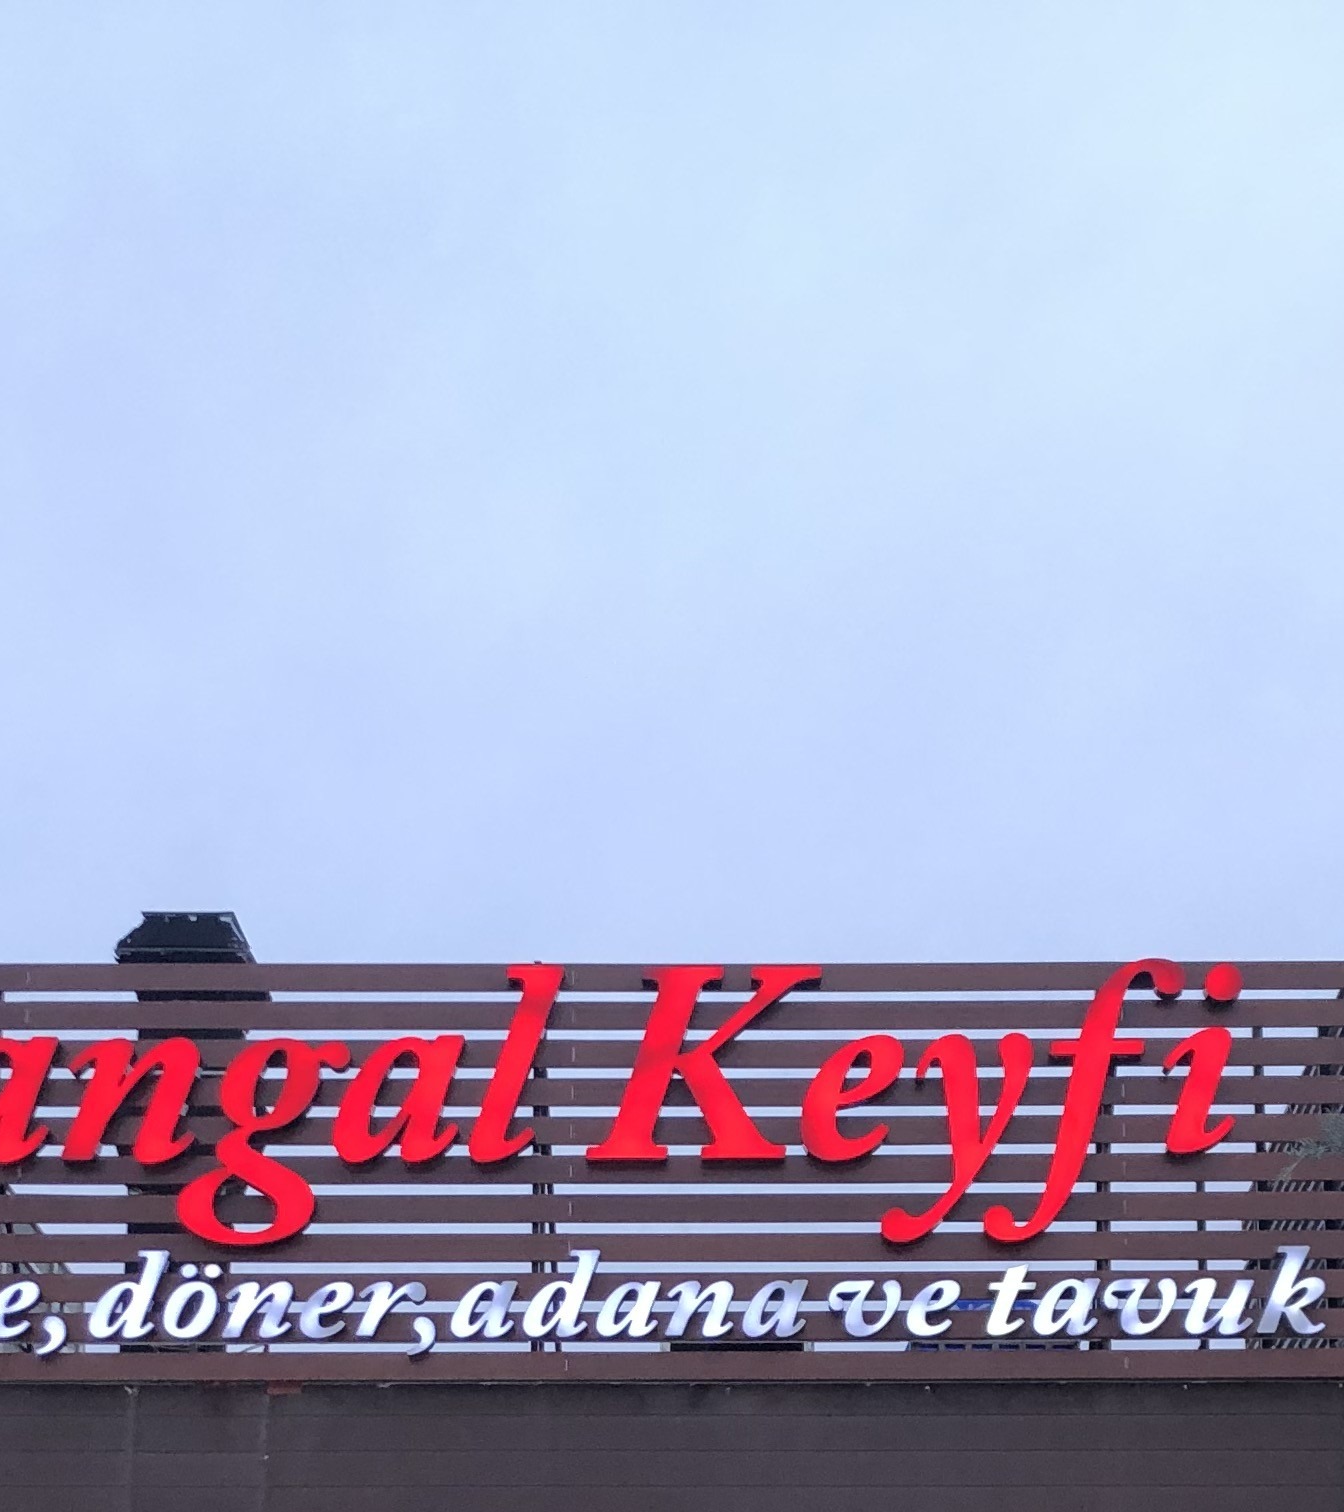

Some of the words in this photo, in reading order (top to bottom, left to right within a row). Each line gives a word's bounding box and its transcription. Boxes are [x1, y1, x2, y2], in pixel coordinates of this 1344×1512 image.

[585, 957, 1244, 1246] Keyfi
[451, 1249, 809, 1339] adana
[829, 1280, 954, 1338] ve
[985, 1245, 1328, 1338] tavuk
